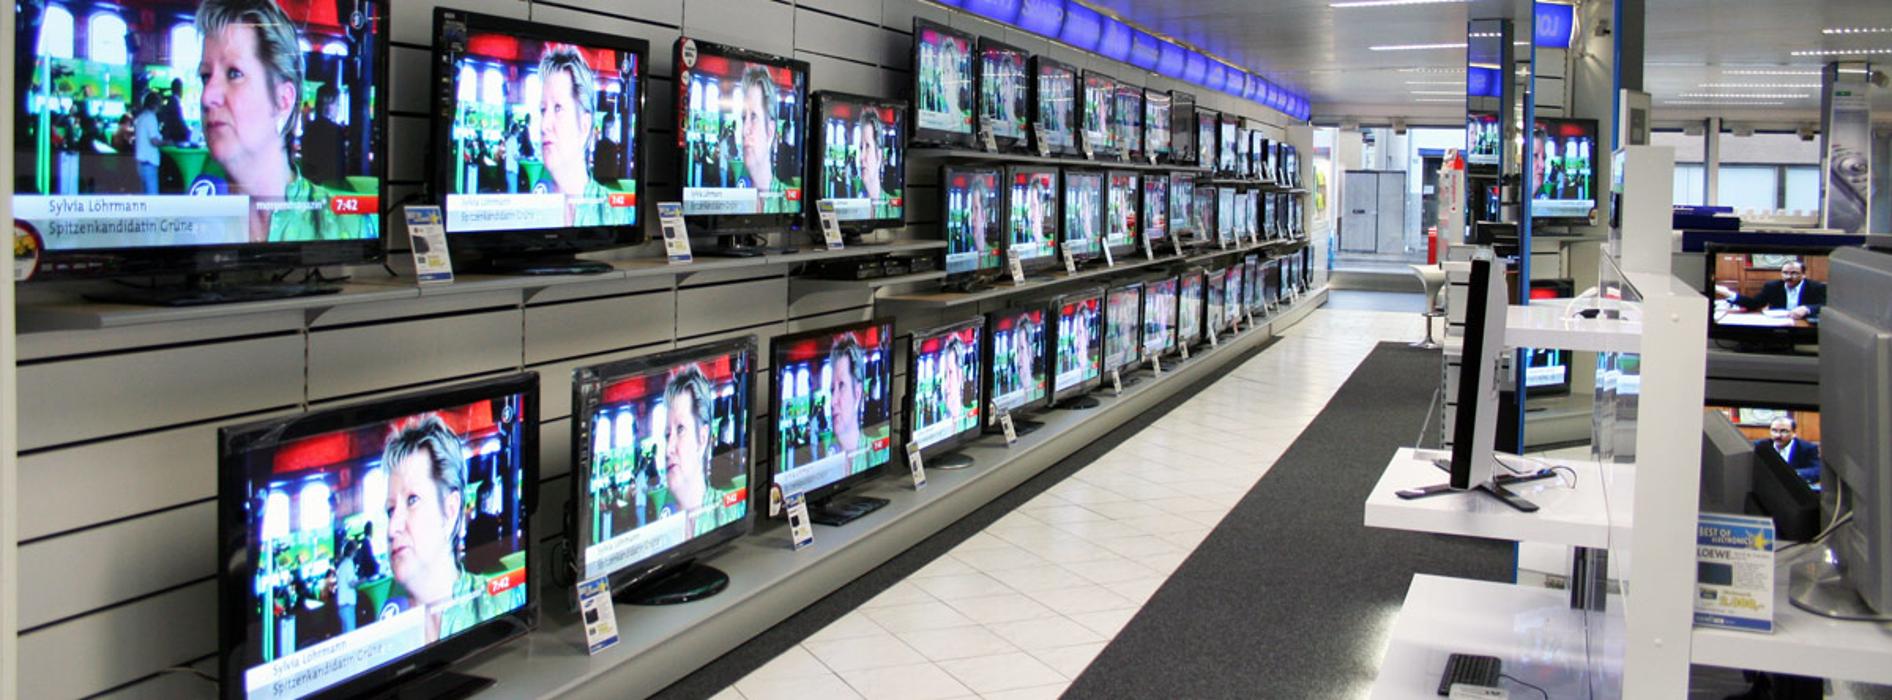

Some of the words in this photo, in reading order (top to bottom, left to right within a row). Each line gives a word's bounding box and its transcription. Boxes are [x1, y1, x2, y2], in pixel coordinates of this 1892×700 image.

[49, 199, 85, 216] Sylvia
[335, 199, 358, 211] 7:42
[48, 219, 157, 237] Spitzenkandidatin
